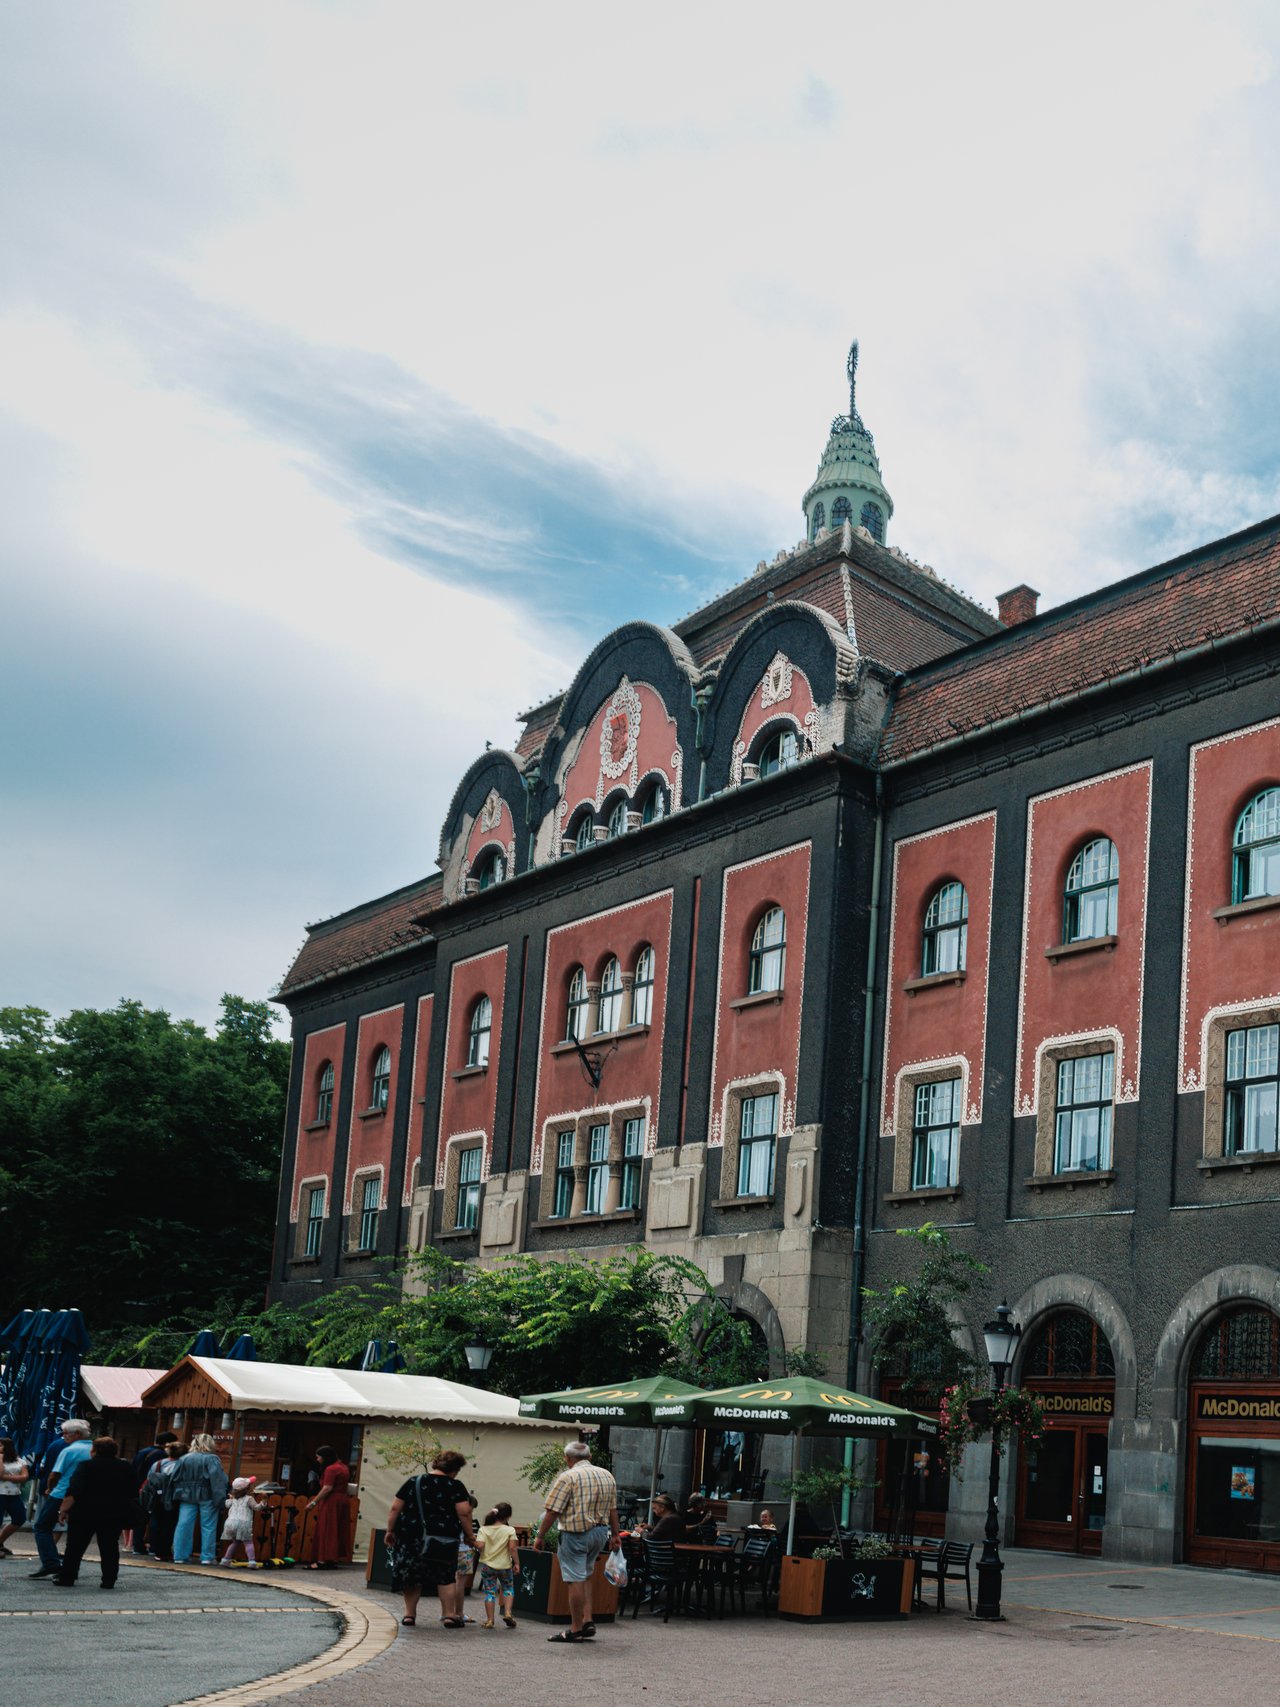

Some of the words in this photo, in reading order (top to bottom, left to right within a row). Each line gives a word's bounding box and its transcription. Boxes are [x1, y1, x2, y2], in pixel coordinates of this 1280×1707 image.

[559, 1405, 626, 1416] McDonald's
[713, 1406, 790, 1420] McDonald's
[828, 1413, 897, 1426] McDonald's
